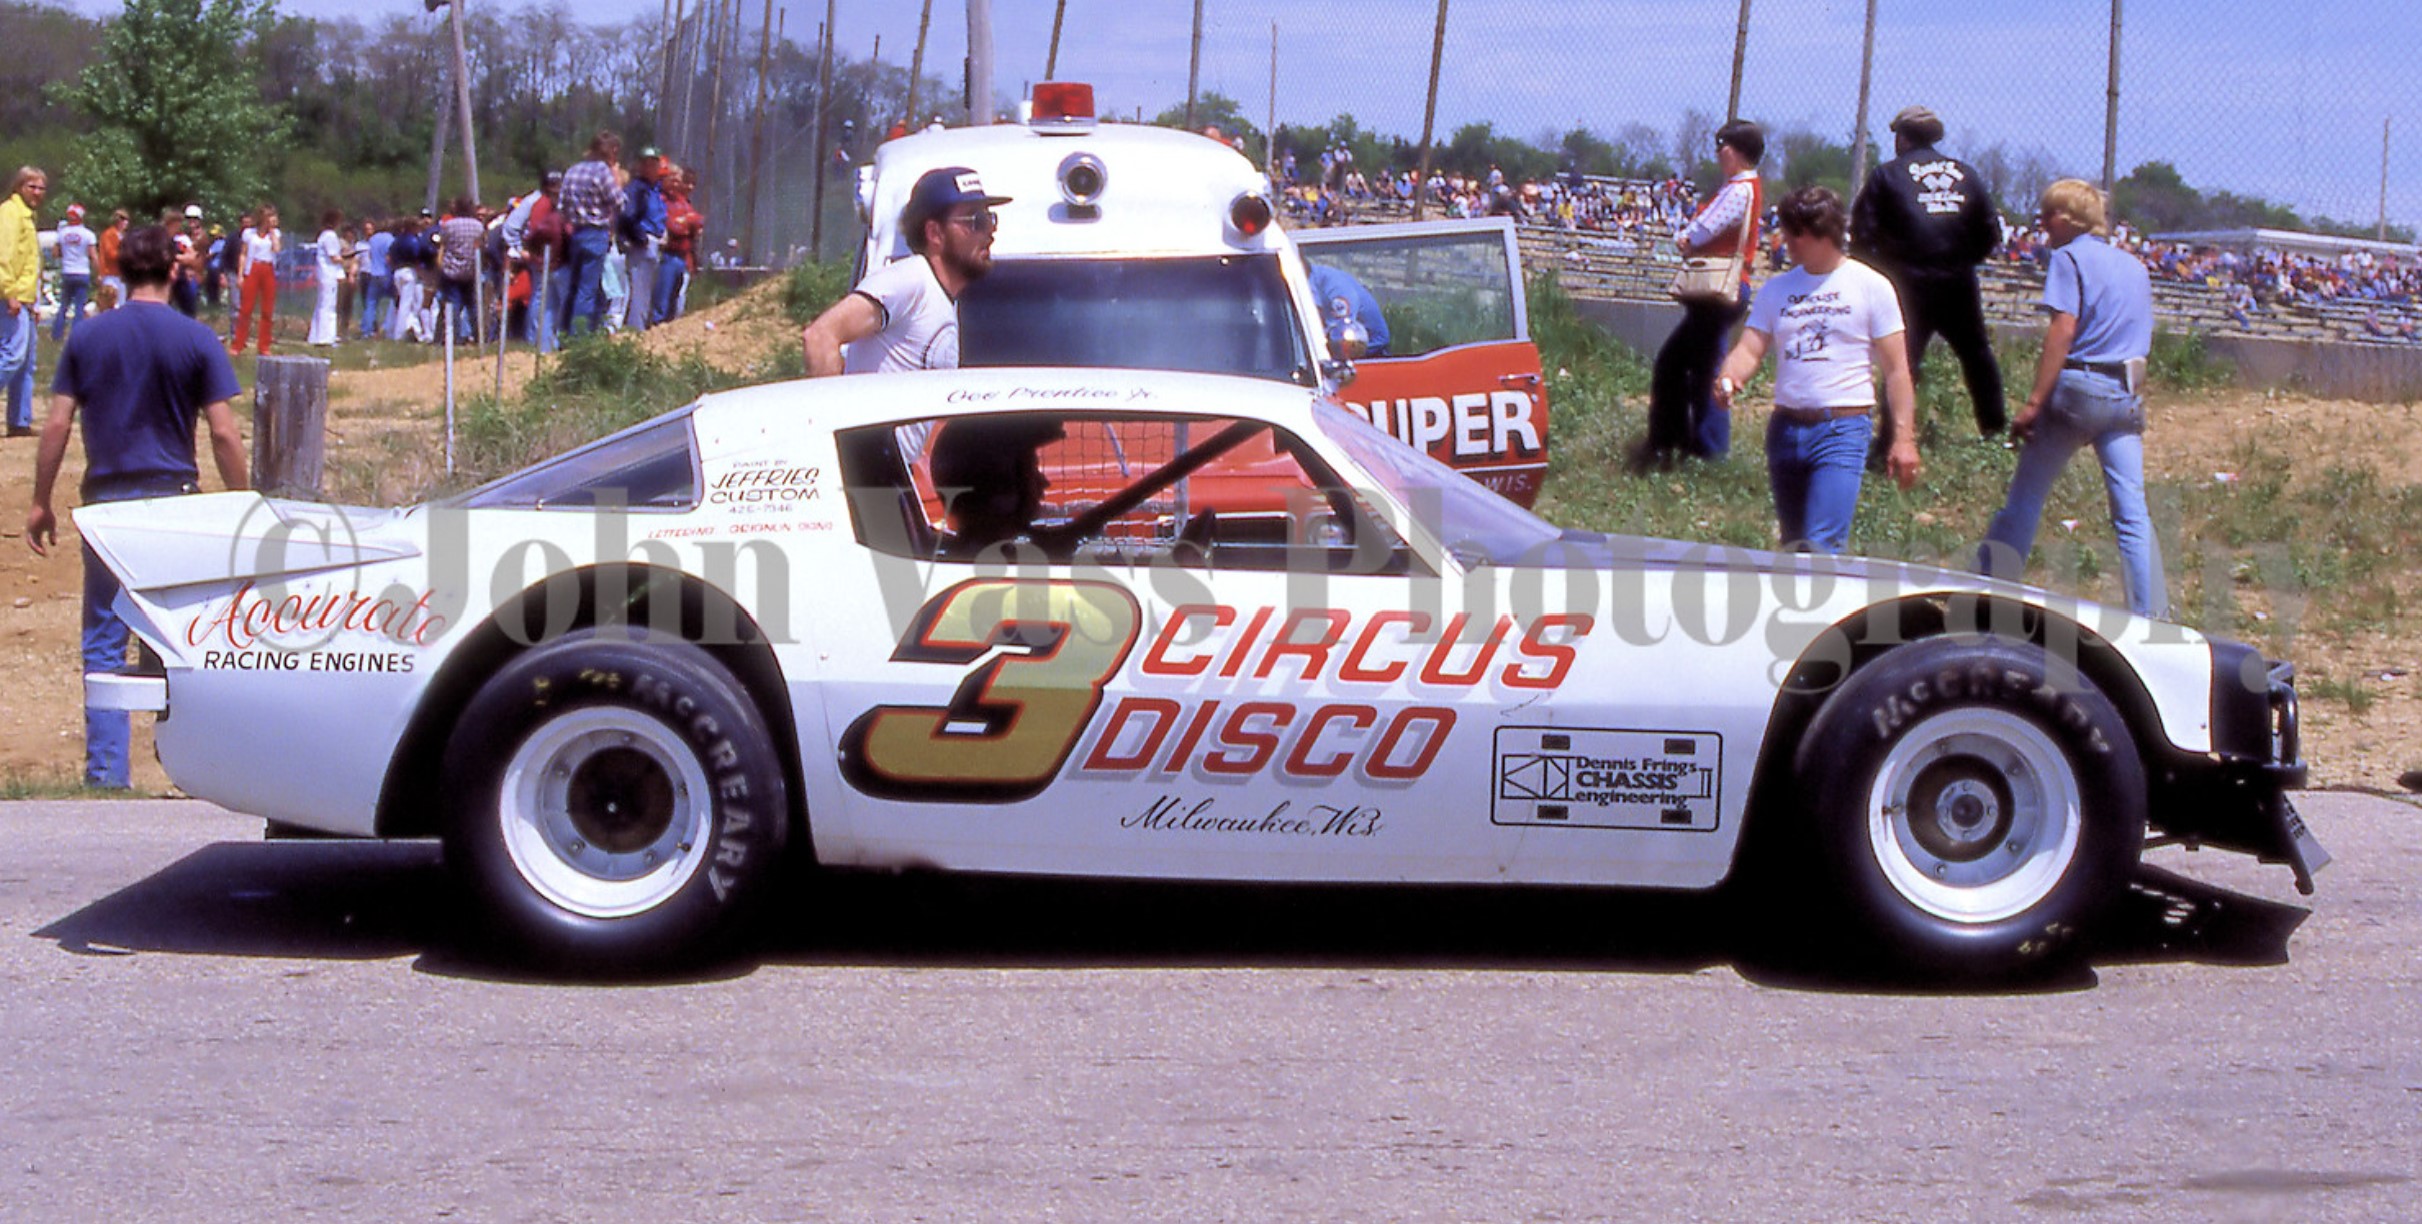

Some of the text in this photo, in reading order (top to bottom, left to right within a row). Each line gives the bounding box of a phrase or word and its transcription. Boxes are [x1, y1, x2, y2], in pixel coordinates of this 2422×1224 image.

[711, 468, 820, 489] JEFFRIES
[710, 488, 820, 504] CUSTOM
[187, 580, 446, 650] Accurate
[1142, 603, 1595, 690] CIRCUS
[203, 651, 415, 673] RACING ENGINES
[840, 577, 1143, 804] 3
[1083, 697, 1459, 779] DISCO
[1575, 756, 1698, 776] Dennis Frings
[1575, 771, 1679, 790] CHASSIS
[1575, 788, 1688, 809] engineering
